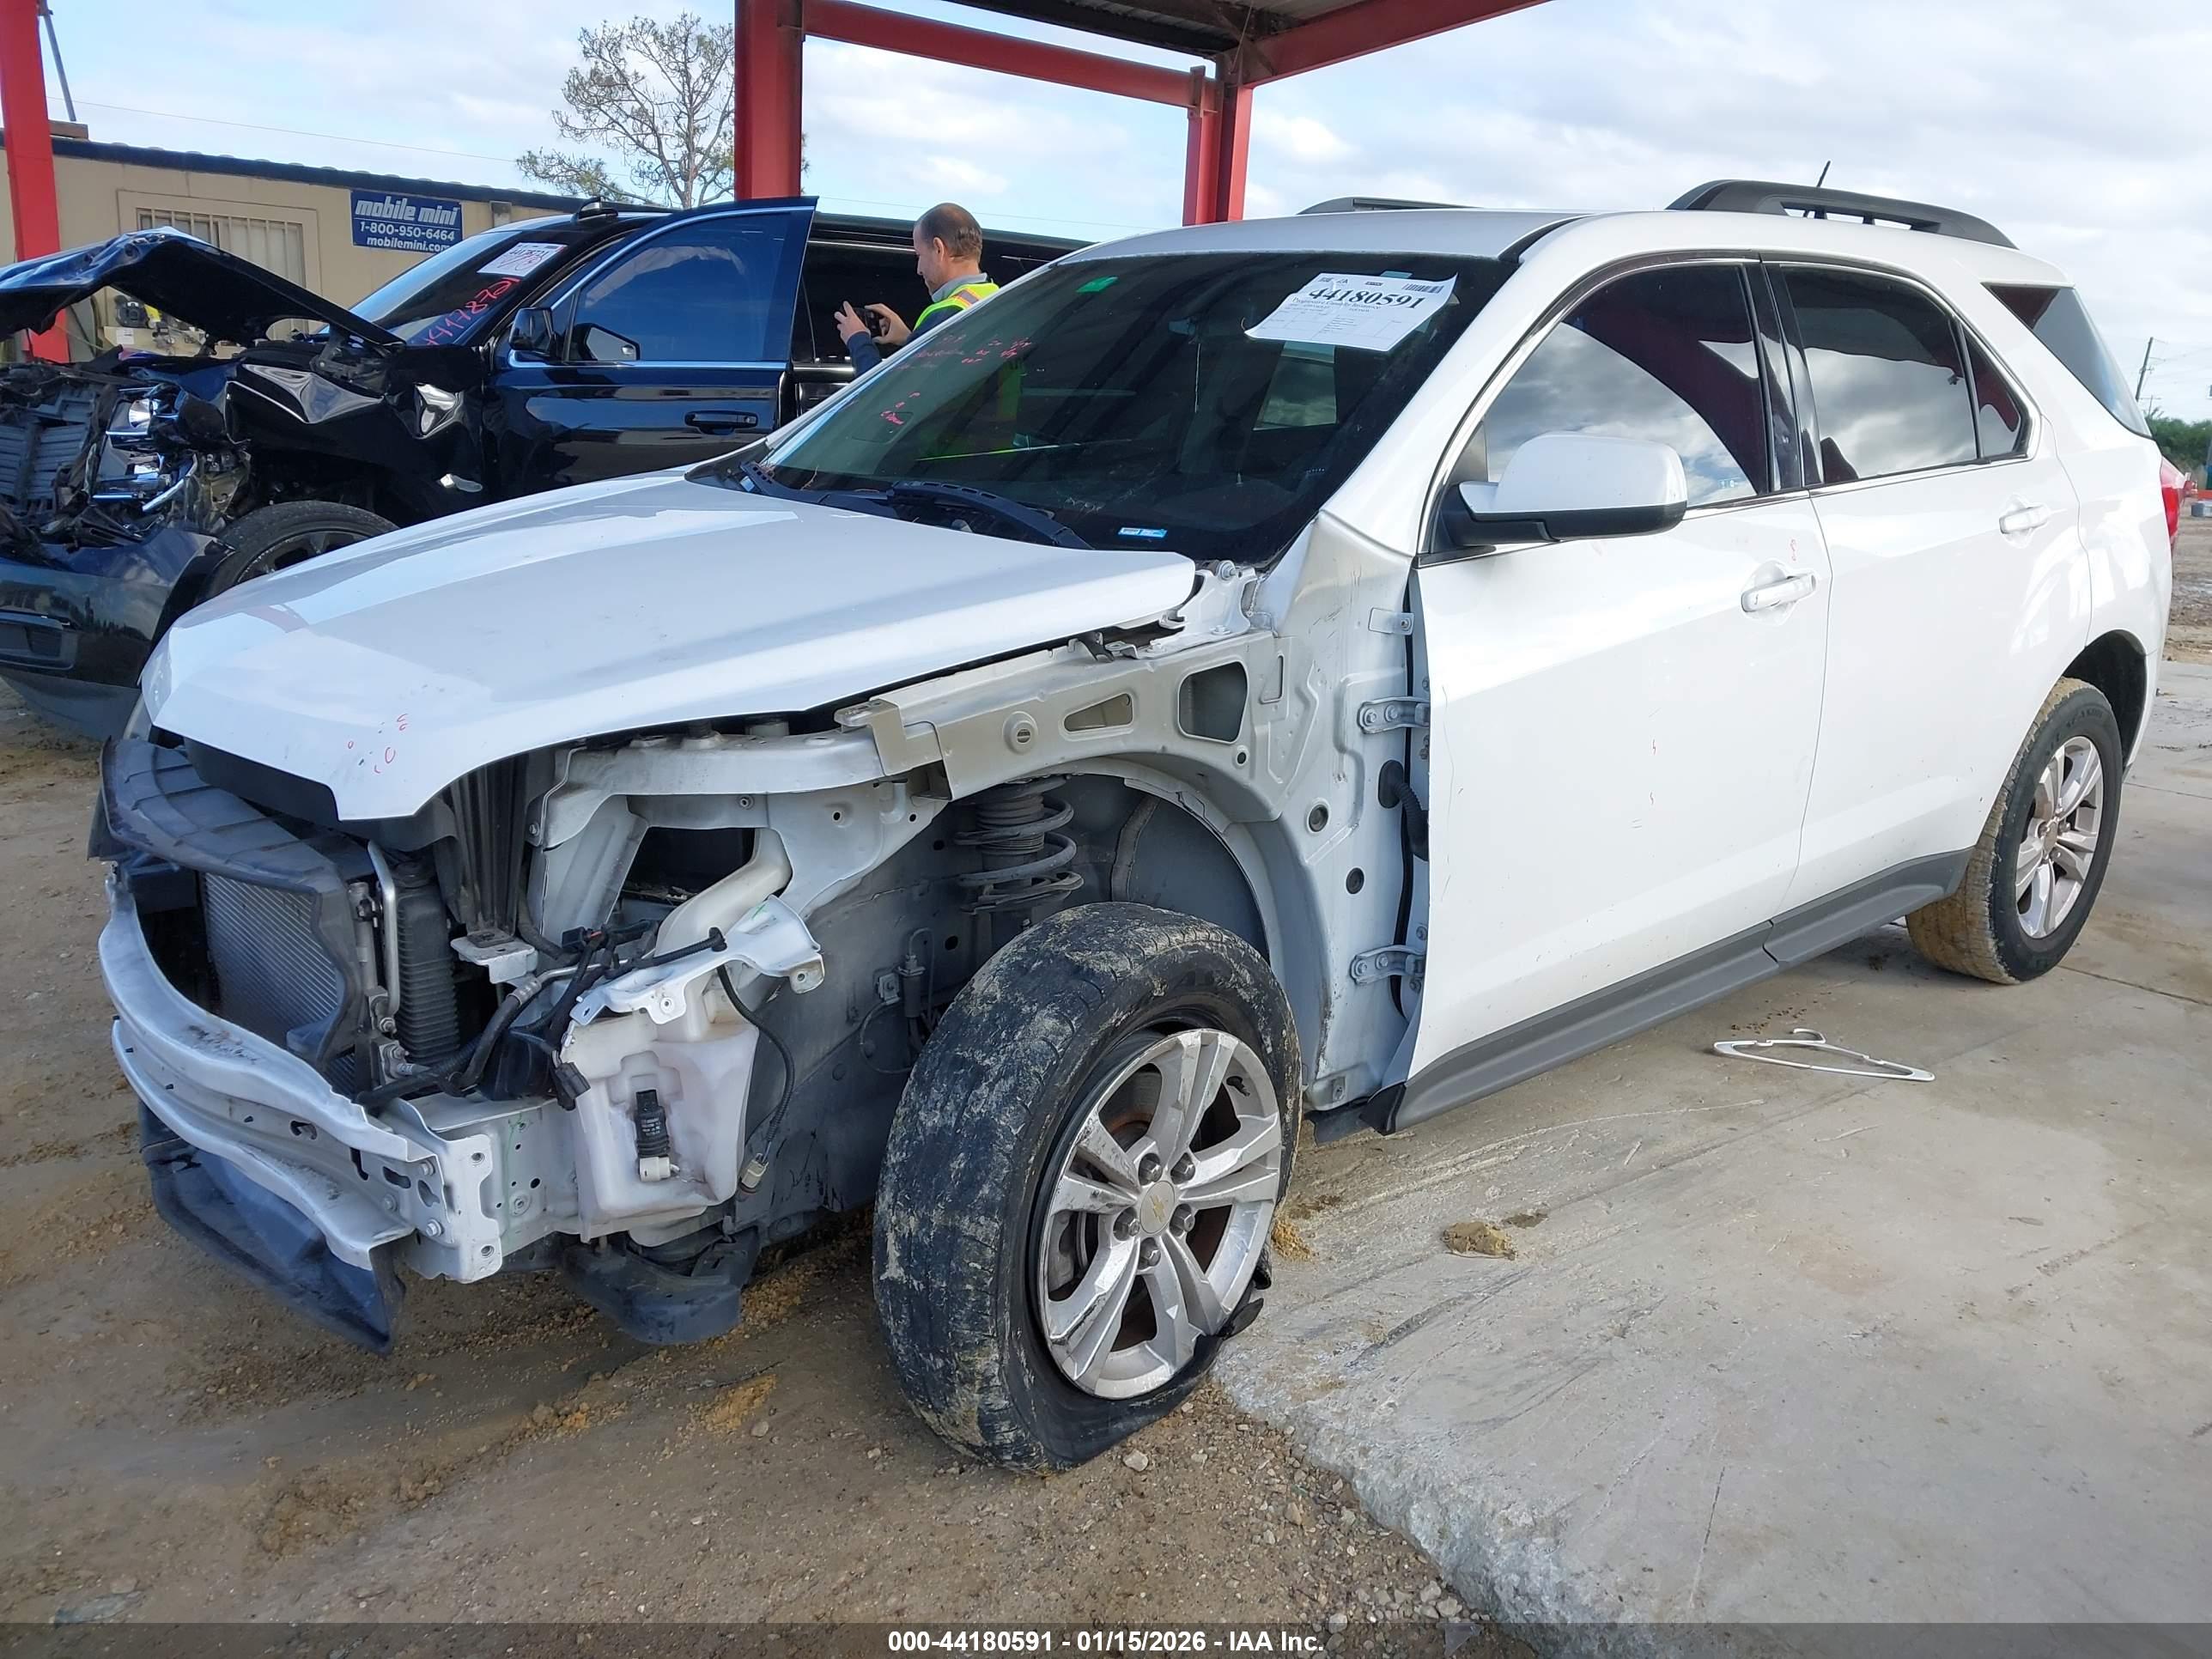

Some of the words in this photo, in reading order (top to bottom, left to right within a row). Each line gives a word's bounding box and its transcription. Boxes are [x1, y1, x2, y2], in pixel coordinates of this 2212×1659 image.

[356, 196, 416, 221] mobile
[418, 205, 459, 225] mini
[360, 221, 454, 241] 1-800-950-6464
[1308, 288, 1425, 309] 44180591
